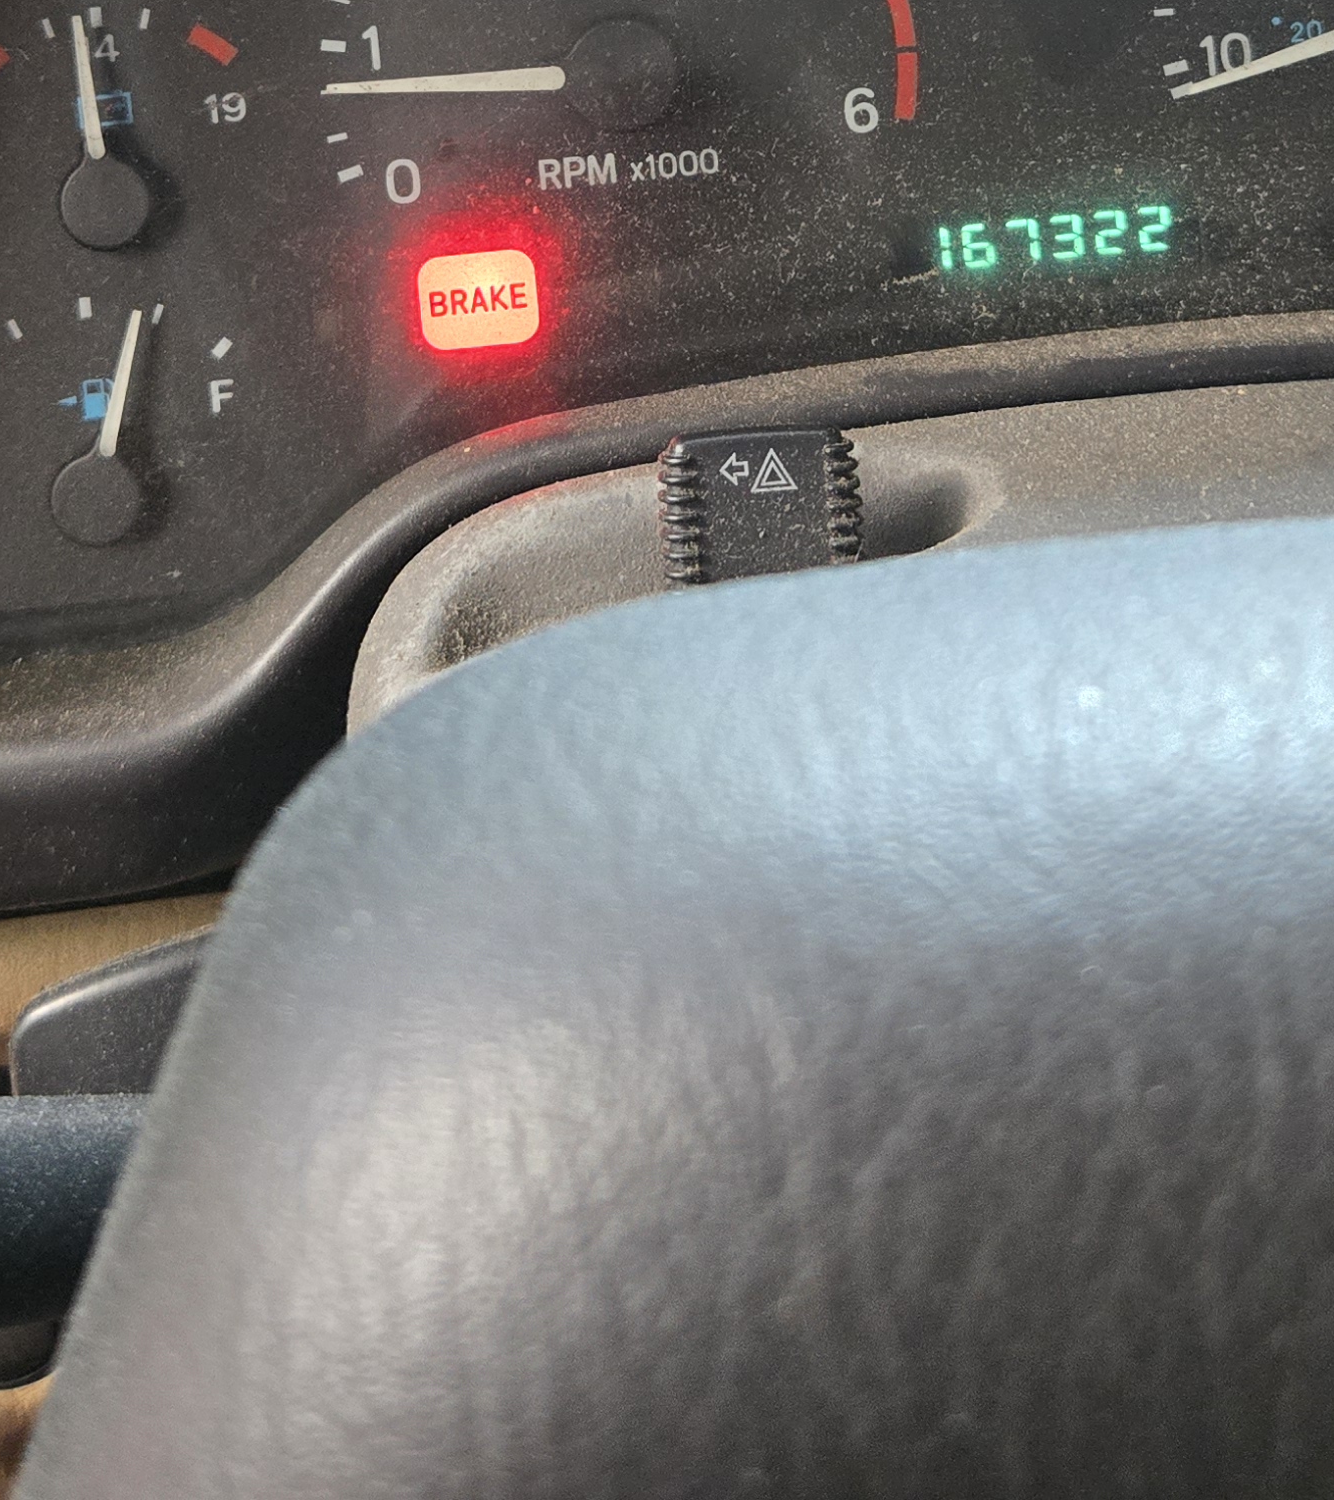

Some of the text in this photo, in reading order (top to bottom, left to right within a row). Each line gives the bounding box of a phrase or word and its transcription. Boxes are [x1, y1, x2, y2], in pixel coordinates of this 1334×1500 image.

[362, 26, 382, 68] 1
[1289, 19, 1322, 43] 20
[1199, 33, 1253, 76] 10
[205, 92, 247, 123] 19
[843, 86, 877, 131] 6
[385, 158, 421, 204] 0
[537, 148, 719, 191] RPM x1000
[938, 205, 1172, 270] 167322
[428, 282, 528, 318] BRAKE
[209, 379, 234, 413] F
